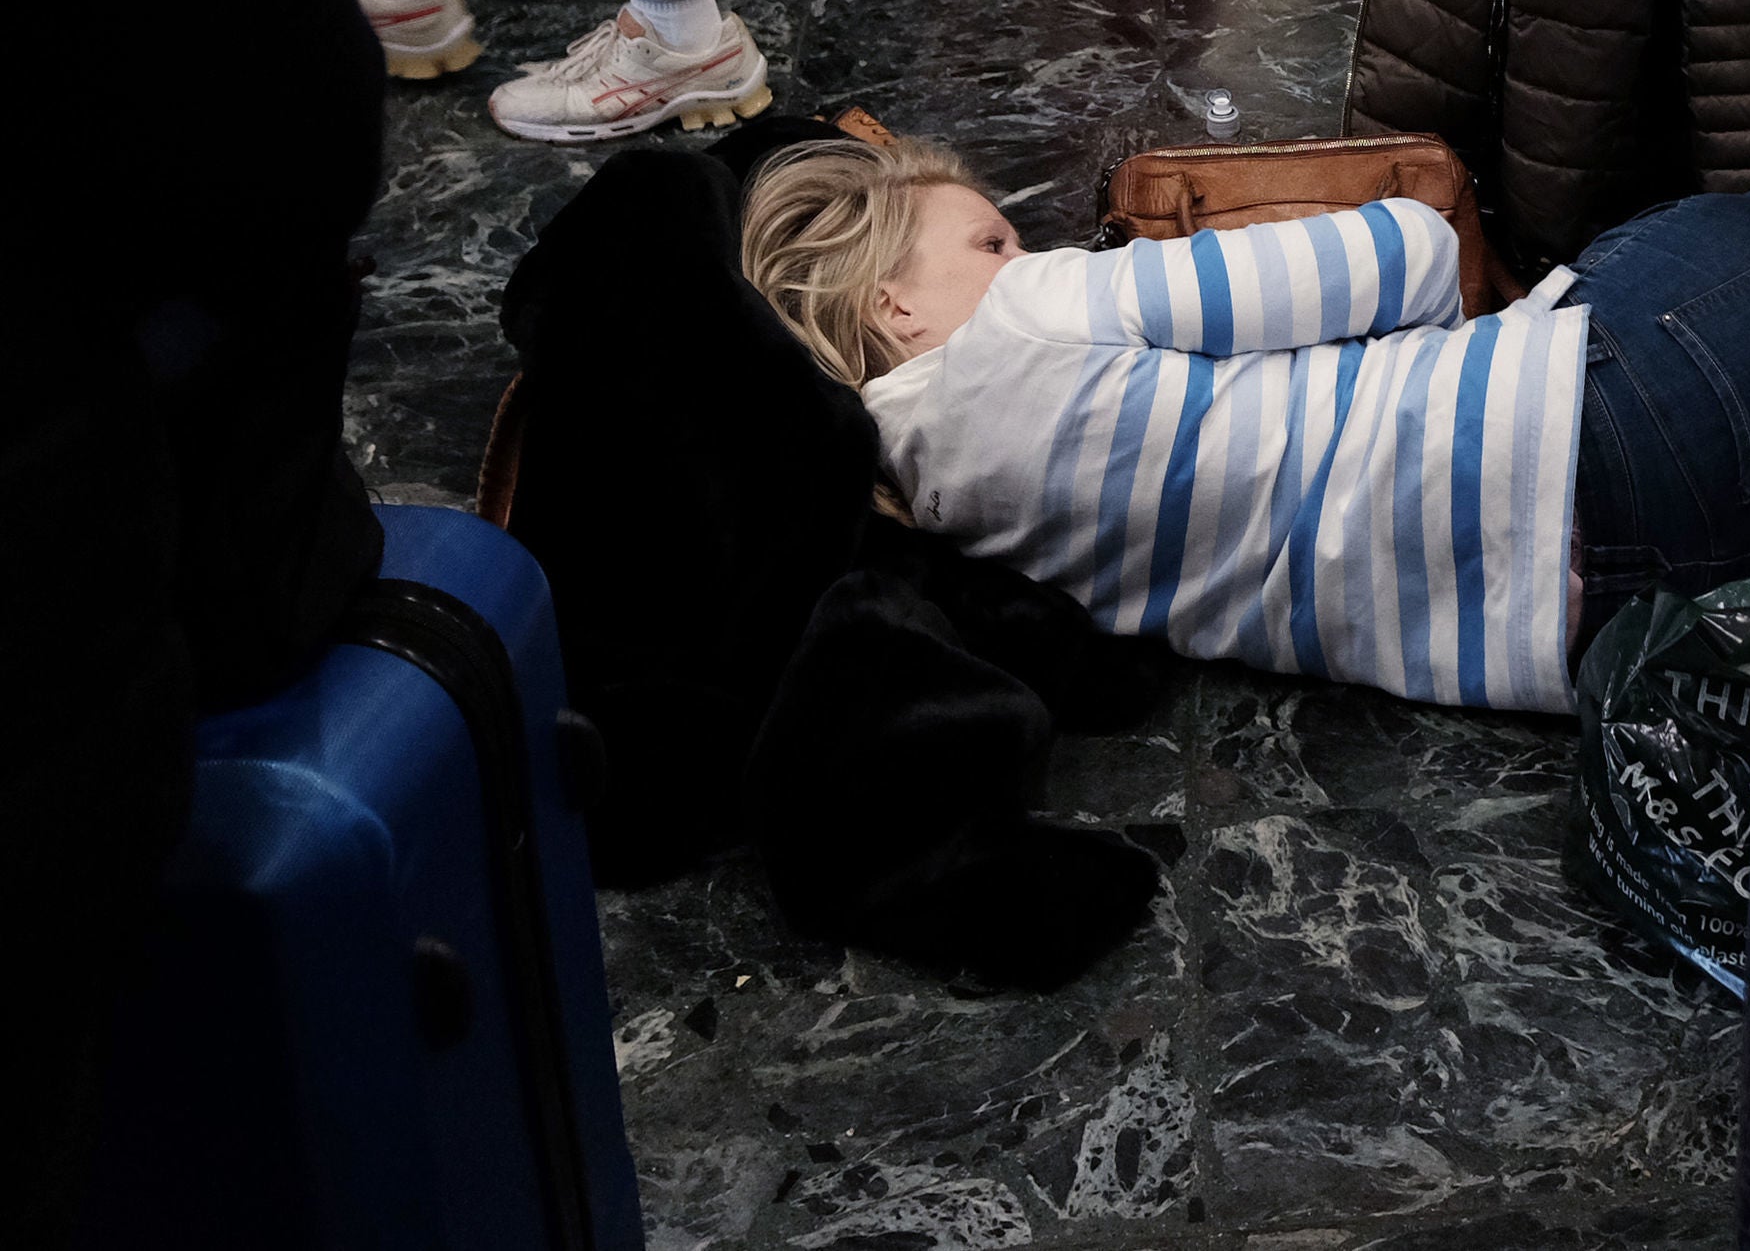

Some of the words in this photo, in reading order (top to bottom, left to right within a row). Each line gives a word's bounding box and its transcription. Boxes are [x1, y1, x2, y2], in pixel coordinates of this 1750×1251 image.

[1618, 761, 1704, 846] M&S
[1590, 802, 1604, 838] bag
[1606, 831, 1614, 852] is
[1616, 851, 1650, 890] made
[1699, 914, 1750, 940] 100%
[1616, 874, 1665, 925] turning
